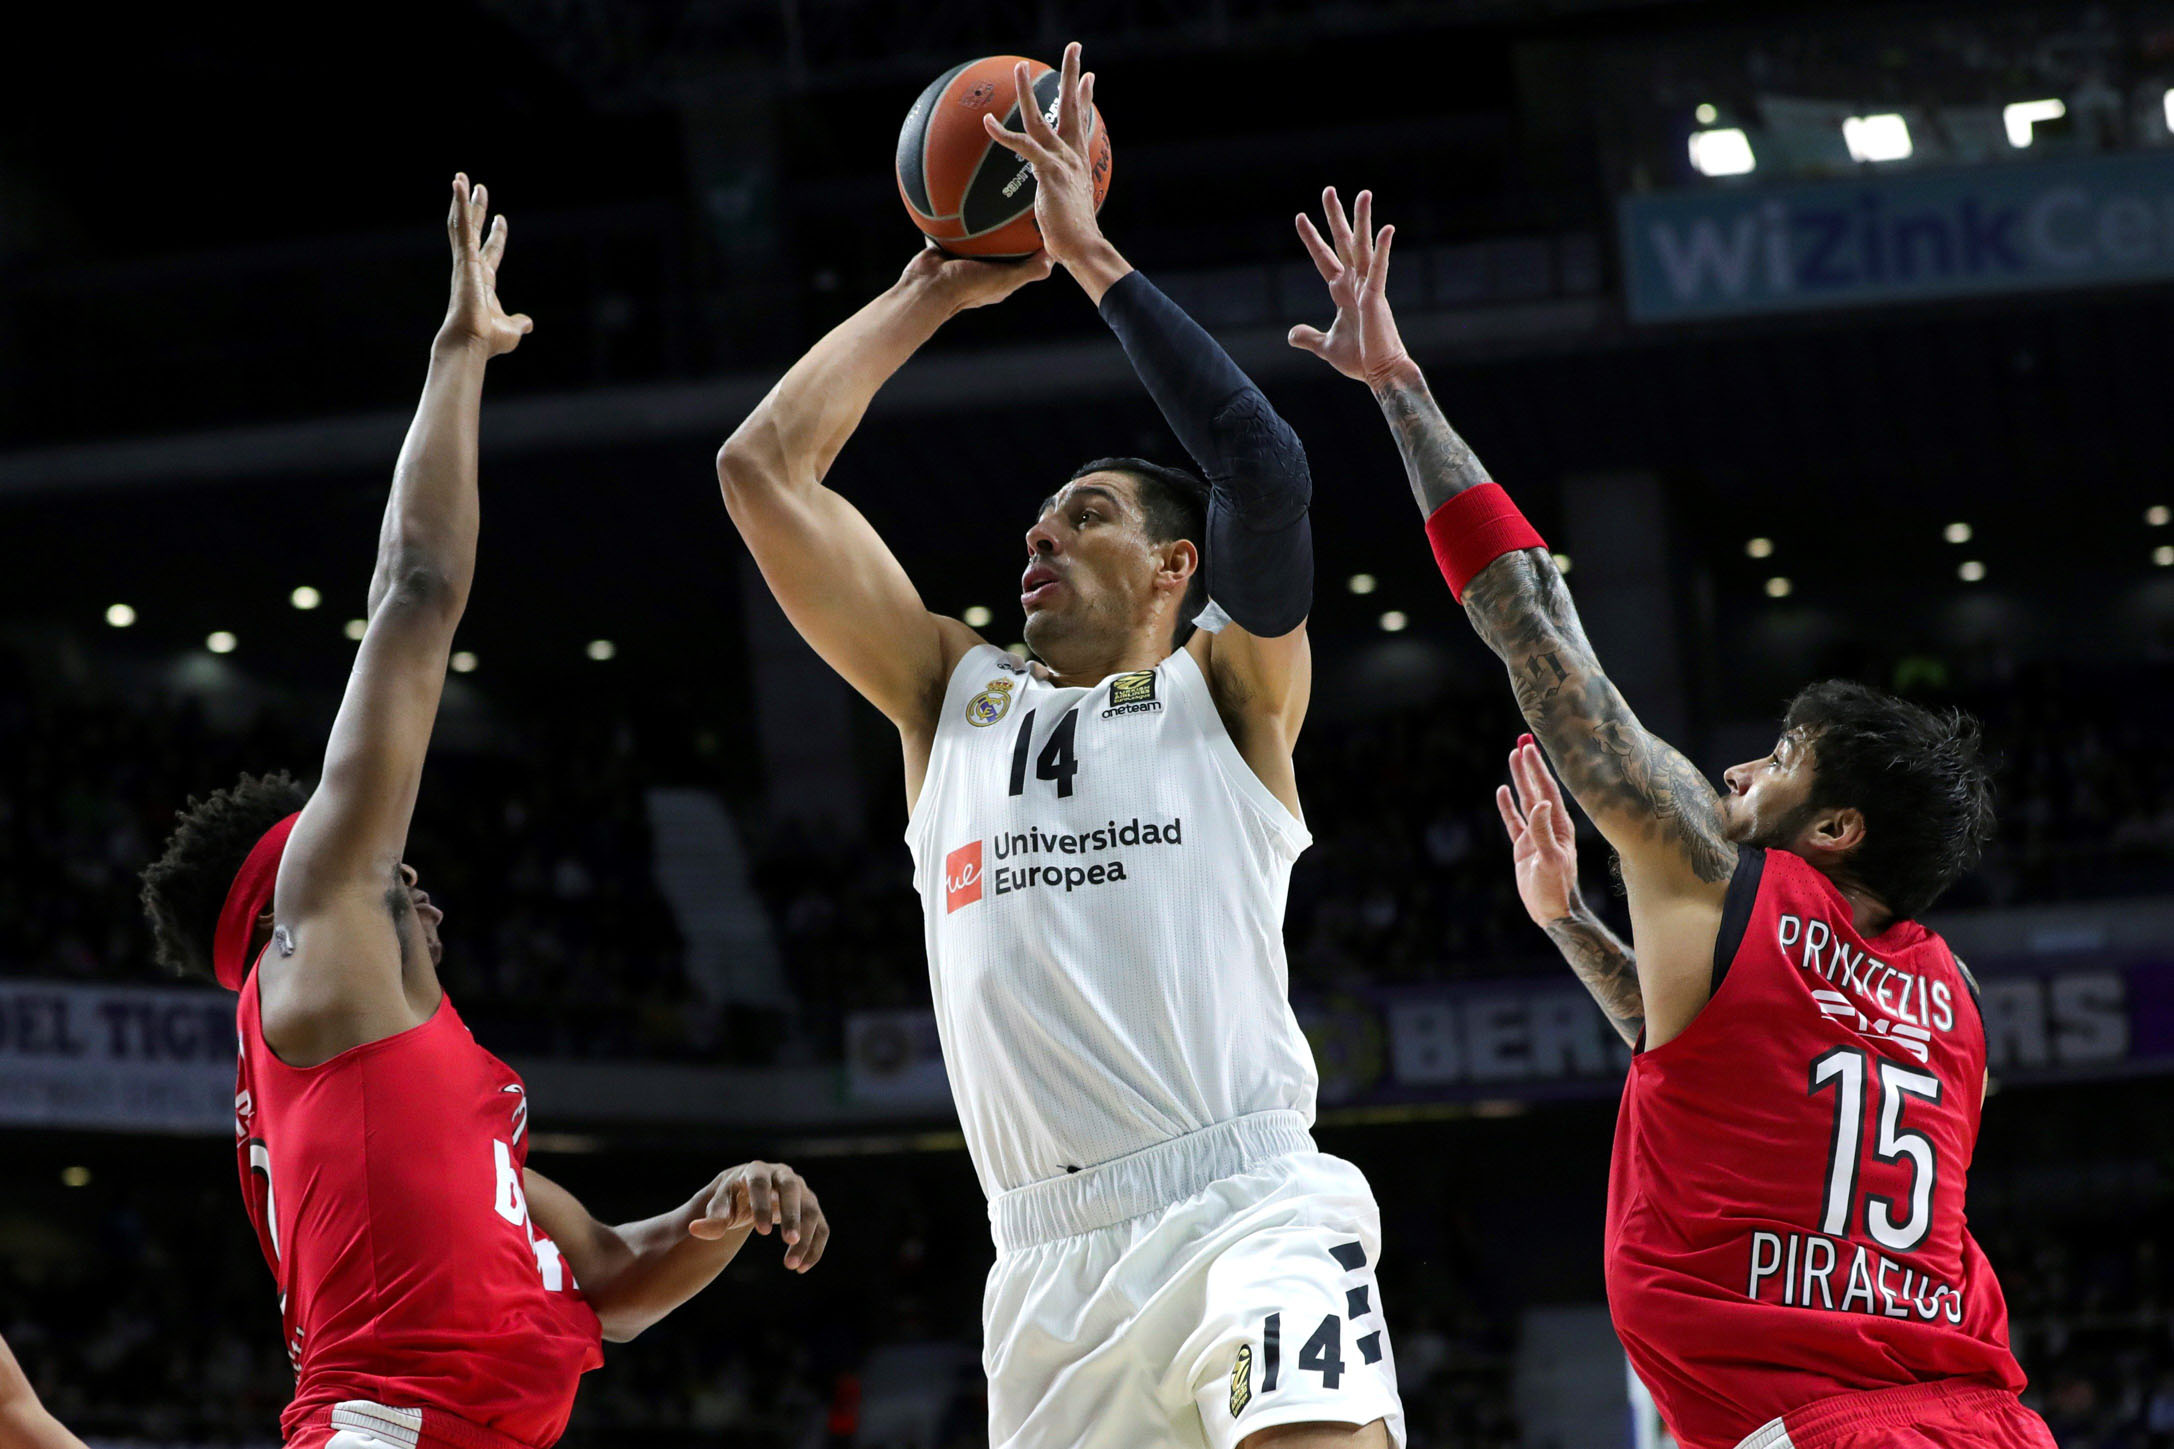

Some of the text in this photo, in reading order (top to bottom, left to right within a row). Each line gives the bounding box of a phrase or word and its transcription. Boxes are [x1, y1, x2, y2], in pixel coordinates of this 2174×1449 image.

[1102, 702, 1161, 718] oneteam
[1009, 707, 1079, 798] 14
[994, 818, 1181, 860] Universidad
[995, 861, 1126, 895] Europea
[1810, 1047, 1941, 1251] 15
[1261, 1312, 1345, 1392] 14
